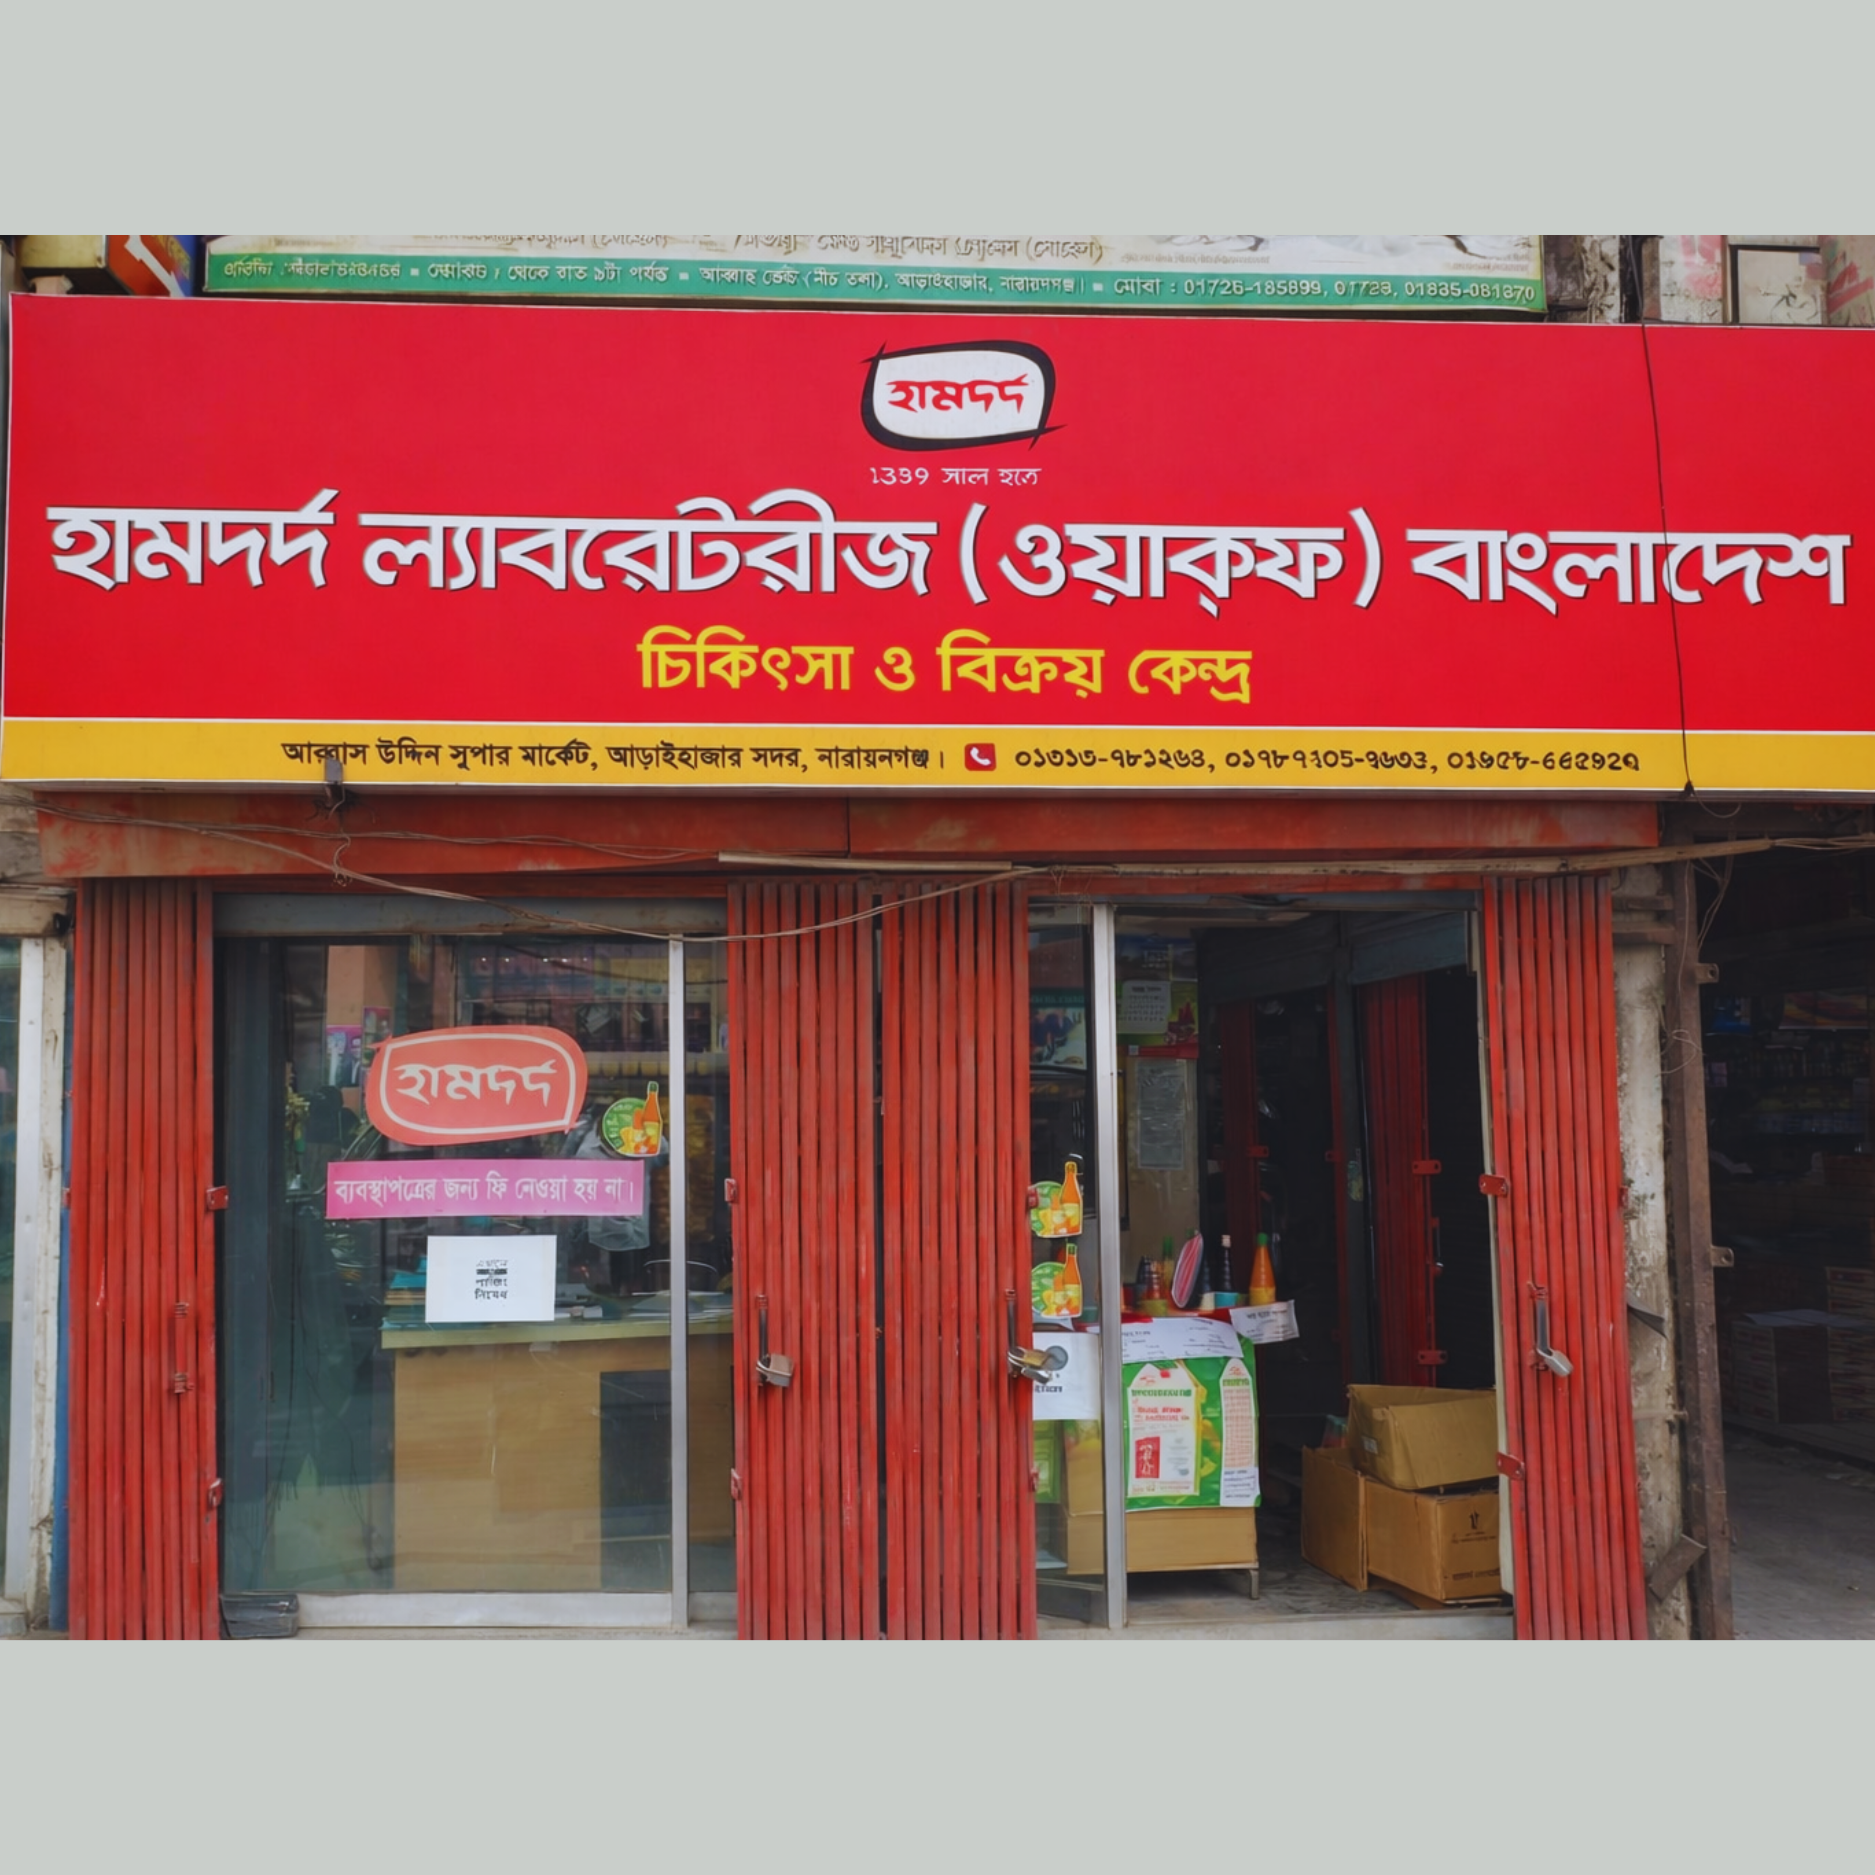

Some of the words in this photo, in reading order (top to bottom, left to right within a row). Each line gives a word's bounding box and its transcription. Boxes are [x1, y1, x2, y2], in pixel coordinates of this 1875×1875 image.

[886, 373, 1029, 413] হামদর্দ
[941, 467, 990, 485] সাল
[997, 468, 1042, 486] হতে
[46, 488, 340, 591] হামদর্দ
[358, 488, 939, 596] ল্যাবরেটরীজ
[1406, 529, 1853, 617] বাংলাদেশ
[636, 624, 855, 692] চিকিৎসা
[874, 646, 915, 692] ও
[935, 628, 1105, 698] বিক্রয়
[1127, 649, 1253, 704] কেন্দ্র
[375, 736, 443, 765] উদ্দিন
[448, 743, 513, 771] সুপার
[518, 738, 598, 772] মার্কেট,
[605, 740, 744, 770] আড়াইহাজার
[749, 747, 808, 773] সদর,
[394, 1059, 558, 1107] হামদর্দ
[334, 1178, 437, 1207] ব্যবস্থাপত্রের
[442, 1177, 480, 1201] জন্য
[485, 1170, 508, 1201] ফি
[515, 1177, 568, 1203] নেওয়া
[573, 1178, 599, 1202] হয়
